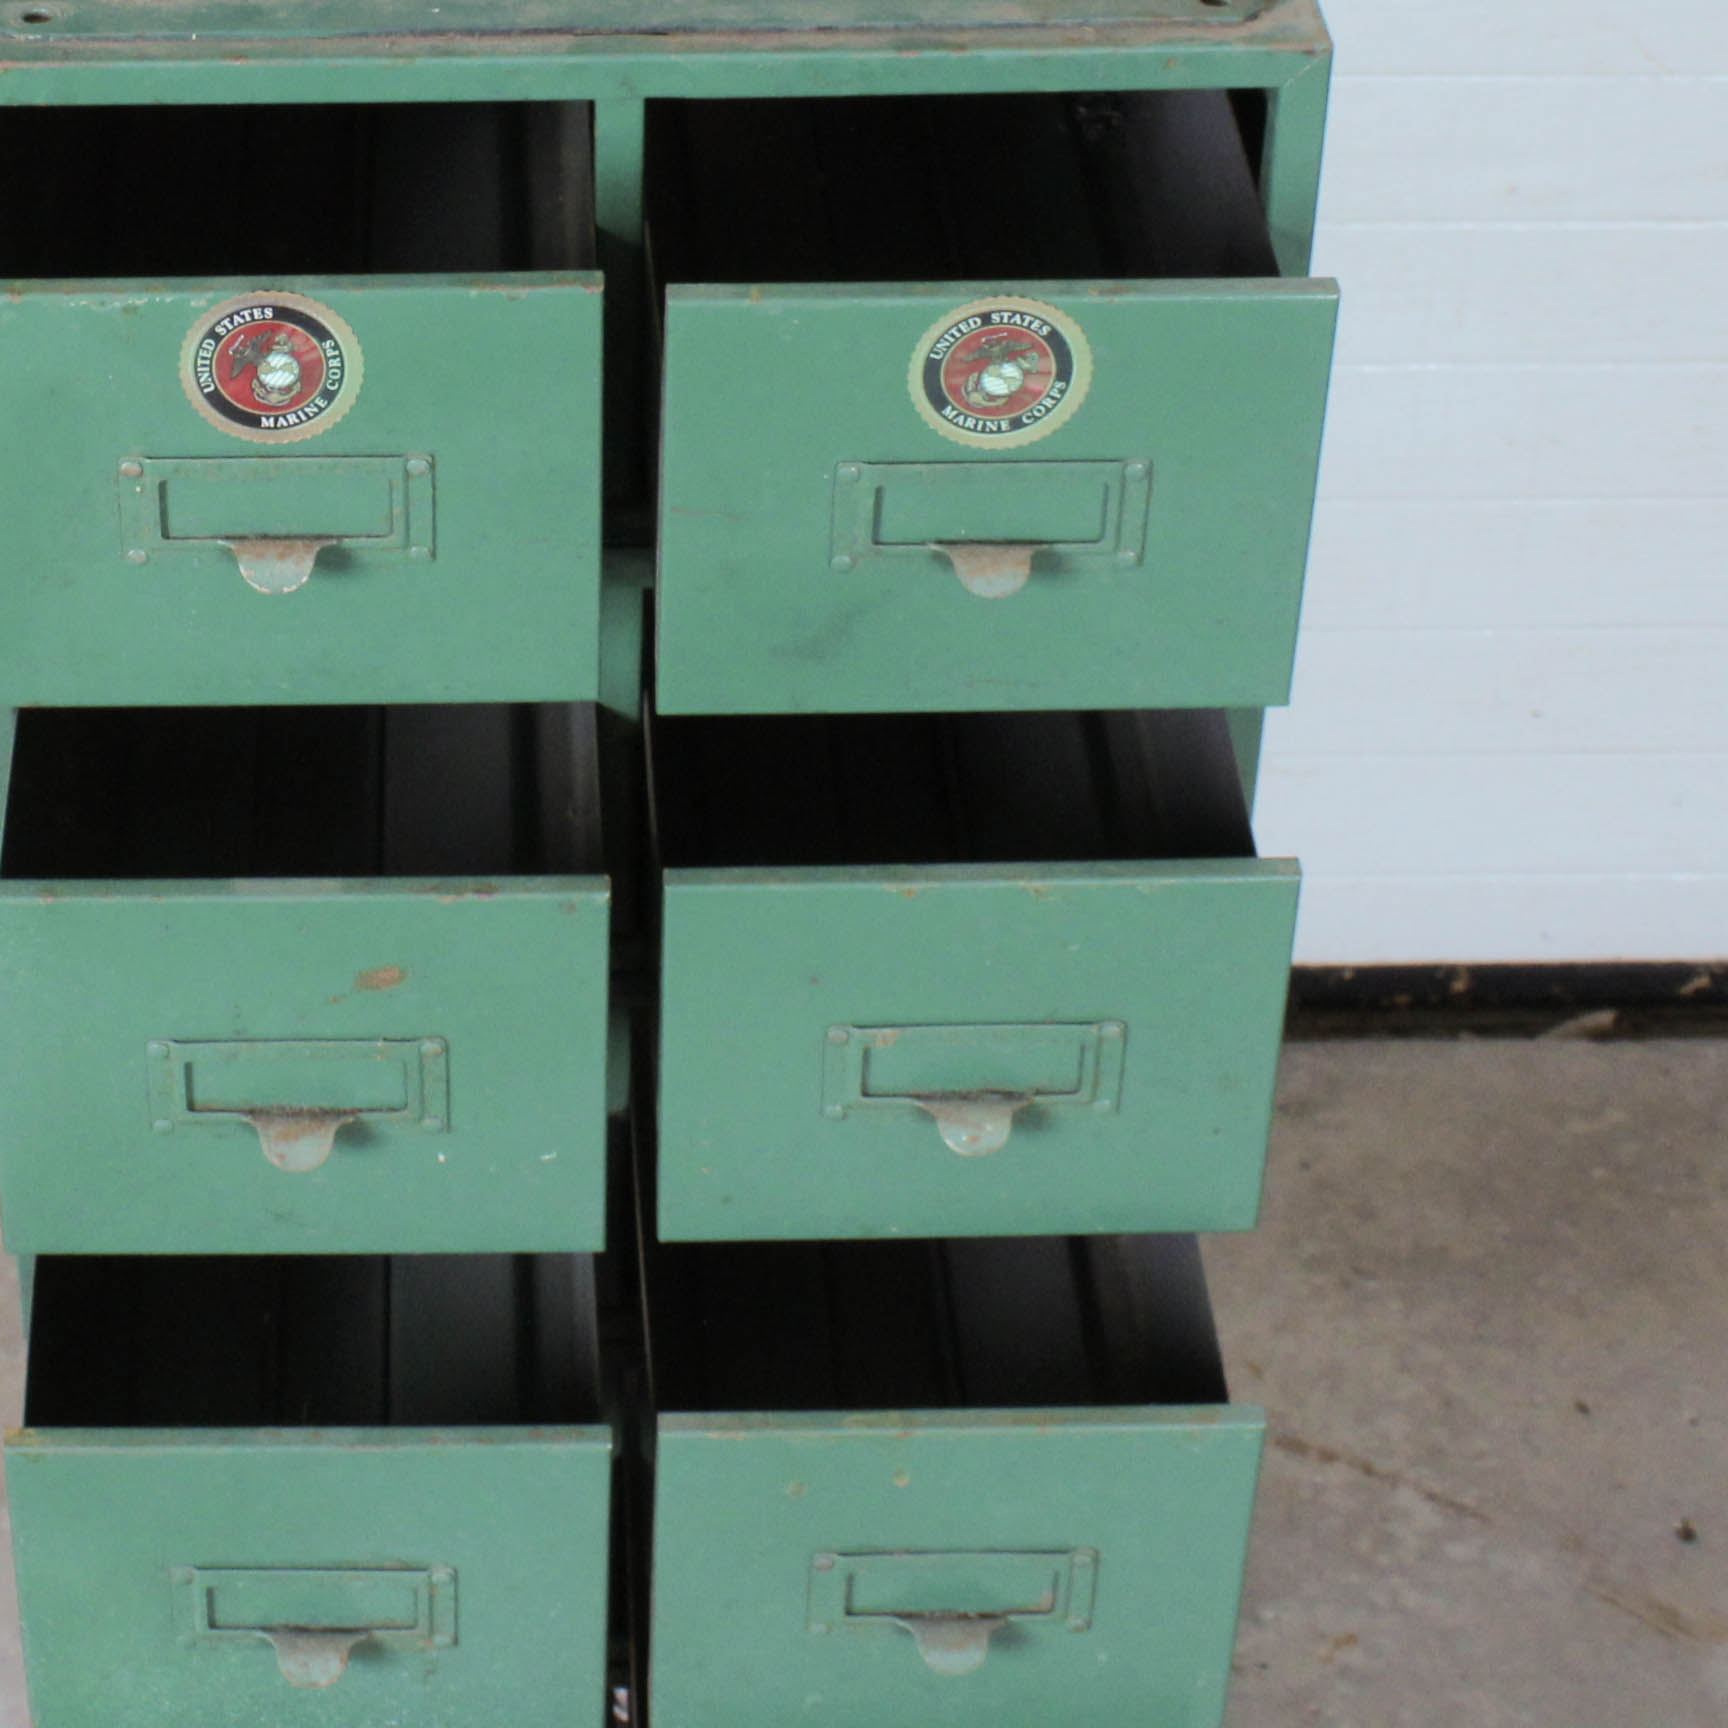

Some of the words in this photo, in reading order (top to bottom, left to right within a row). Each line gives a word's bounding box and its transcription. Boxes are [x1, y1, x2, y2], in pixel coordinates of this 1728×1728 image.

[196, 338, 216, 394] UNITED
[214, 307, 274, 336] STATES
[928, 316, 982, 361] UNITED
[990, 311, 1053, 337] STATES
[260, 396, 329, 428] MARINE
[321, 338, 342, 391] CORPS
[941, 405, 1011, 433] MARINE
[1021, 380, 1067, 425] CORPS
